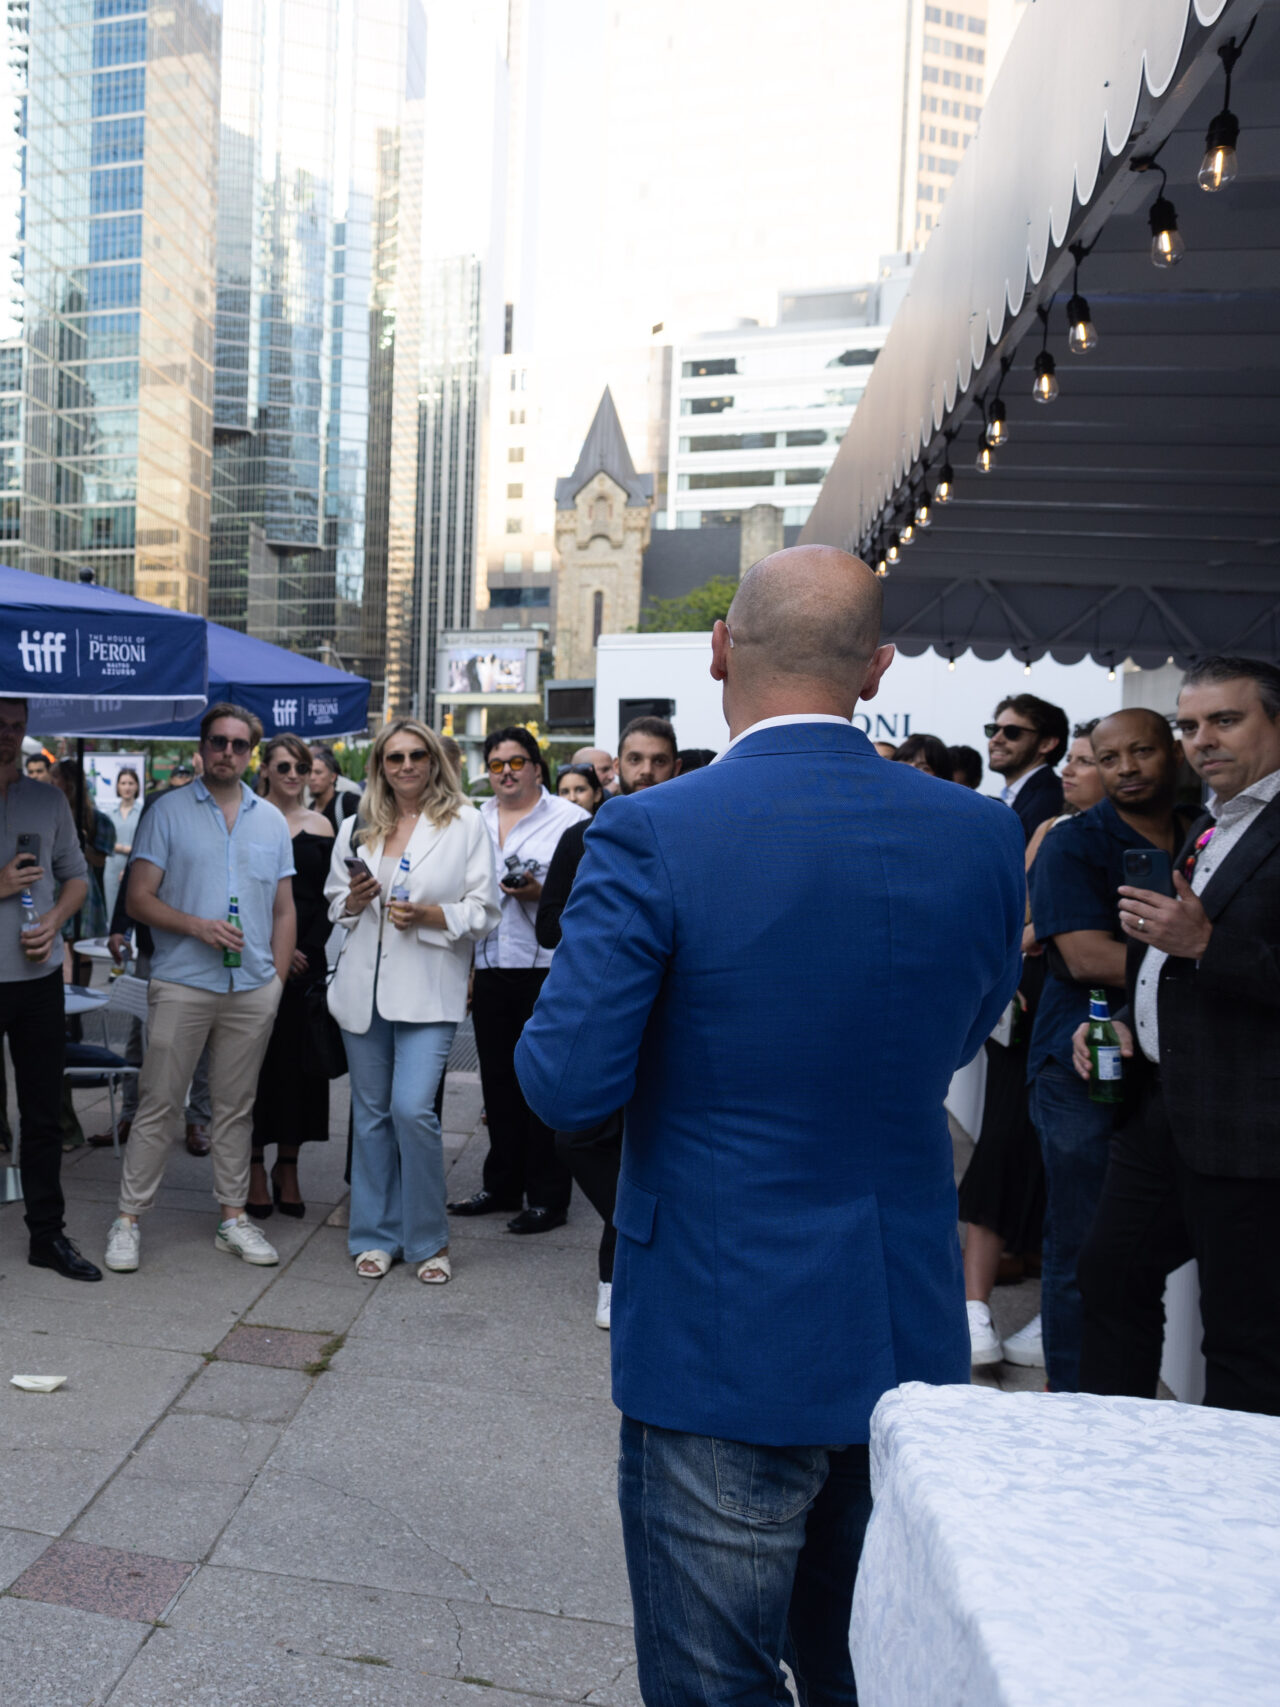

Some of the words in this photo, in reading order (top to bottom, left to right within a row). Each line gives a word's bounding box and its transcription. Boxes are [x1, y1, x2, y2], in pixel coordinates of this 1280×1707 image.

[89, 634, 103, 642] THE
[107, 635, 132, 643] HOUSE
[17, 630, 67, 673] tiff
[88, 641, 146, 662] PERONI
[272, 699, 298, 727] tiff
[307, 702, 339, 717] PERONI
